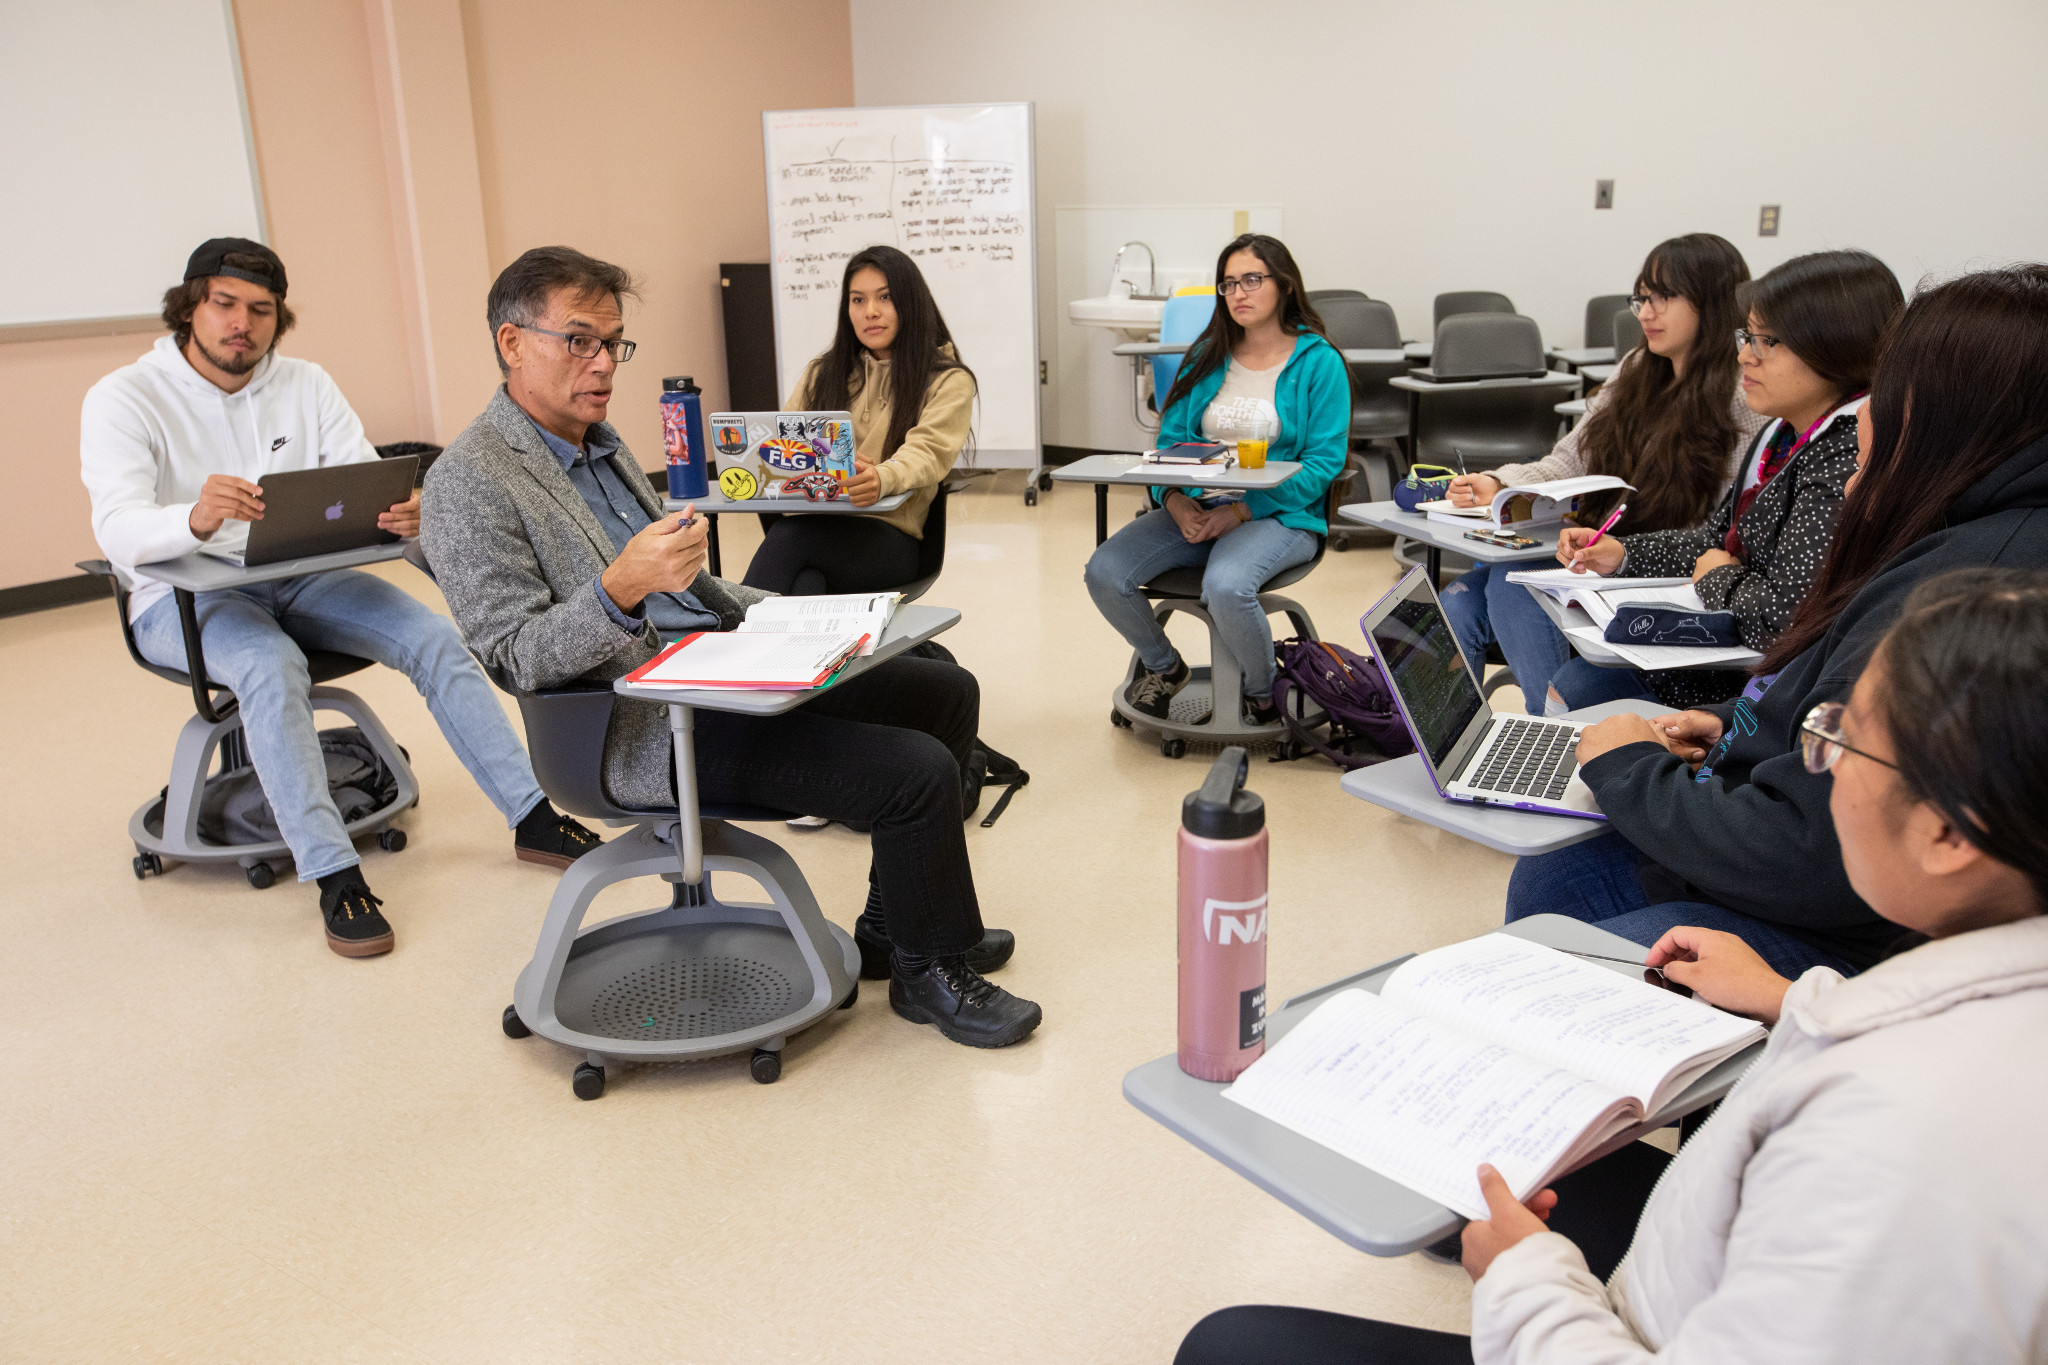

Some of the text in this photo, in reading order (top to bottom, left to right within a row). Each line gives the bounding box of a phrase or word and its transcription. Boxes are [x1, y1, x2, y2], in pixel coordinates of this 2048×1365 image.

[1232, 396, 1257, 410] THE
[1207, 402, 1254, 421] NORTH
[273, 436, 286, 446] NIKE
[768, 449, 808, 470] FLG
[1633, 618, 1650, 633] Hello
